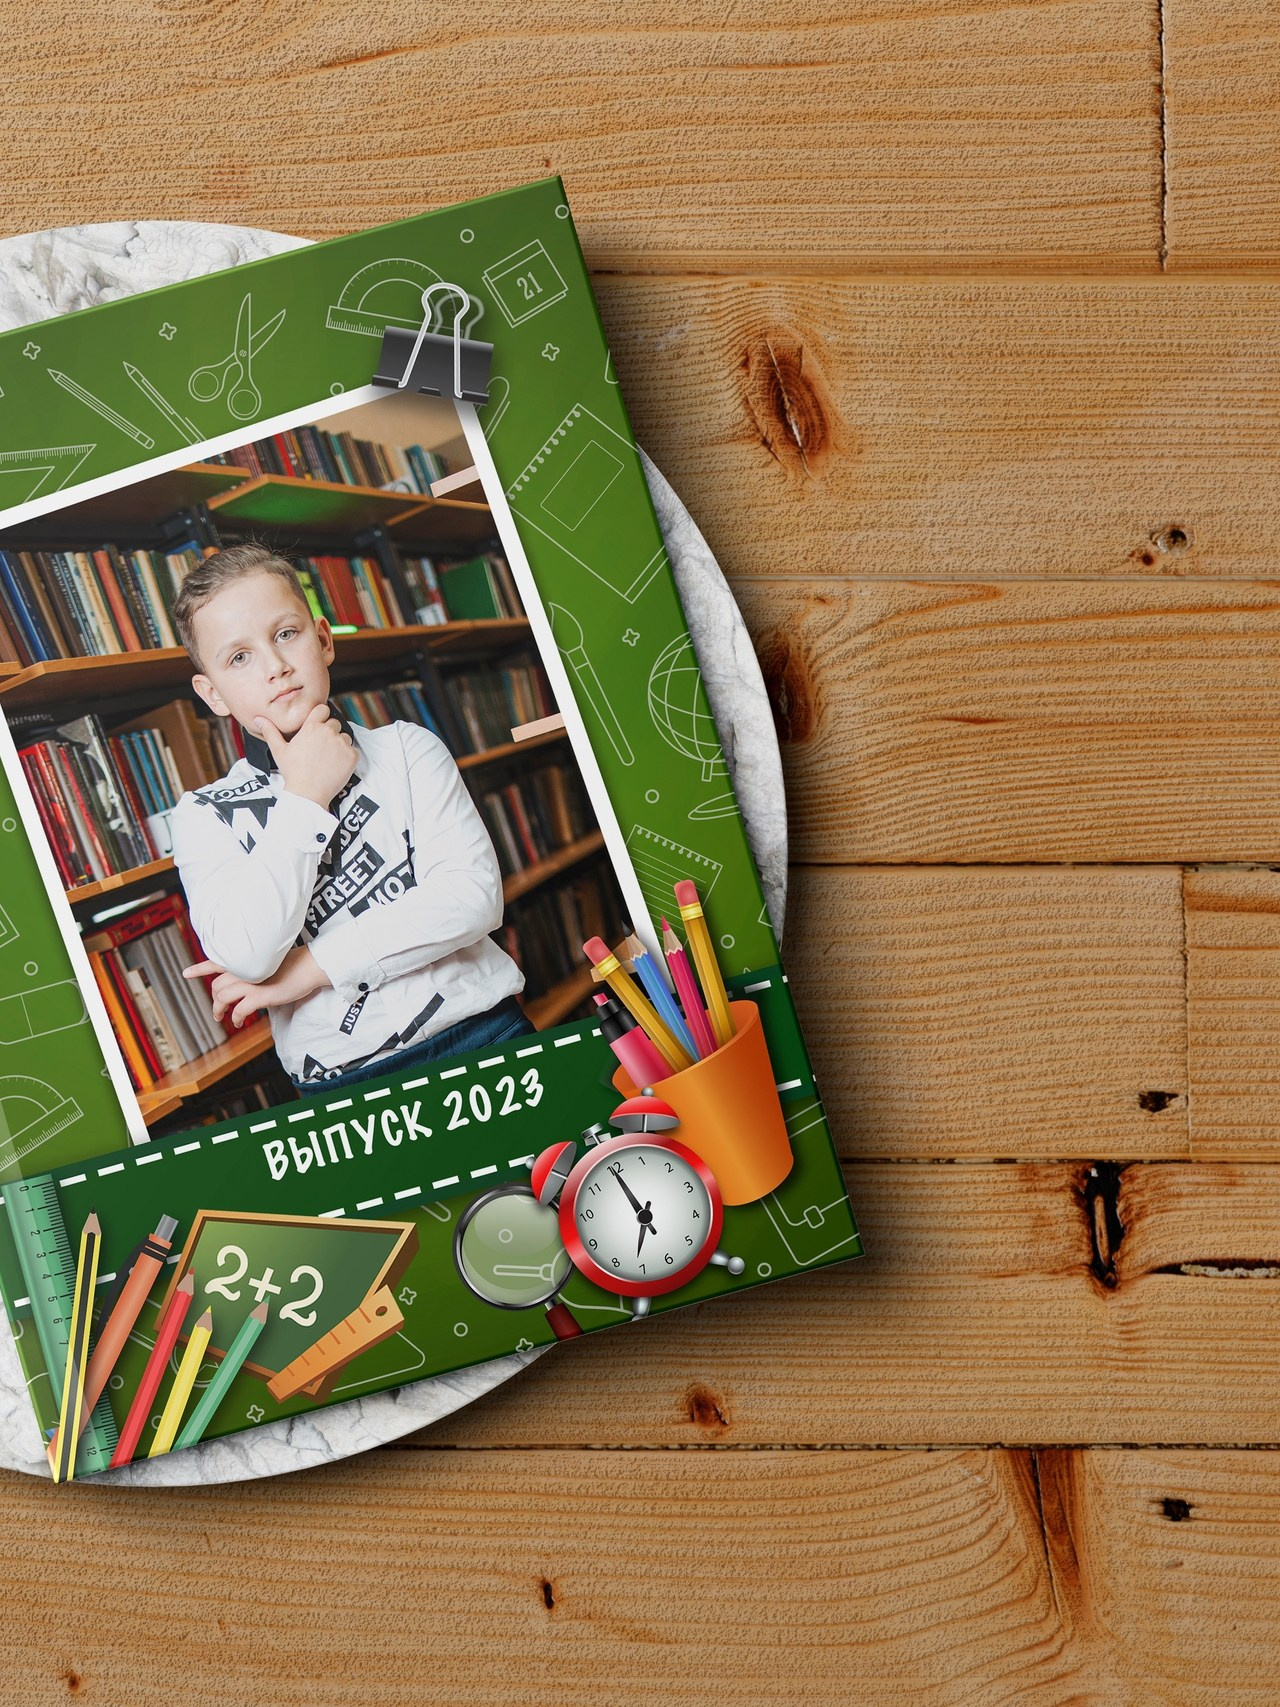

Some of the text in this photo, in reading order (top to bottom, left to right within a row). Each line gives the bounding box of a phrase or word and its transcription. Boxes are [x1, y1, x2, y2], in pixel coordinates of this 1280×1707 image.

[516, 271, 543, 300] 21
[202, 780, 263, 800] YOUR
[339, 804, 370, 850] DGE
[306, 849, 378, 928] STREET
[343, 1002, 363, 1031] JUST
[262, 1068, 544, 1181] ВЫПУСК 2023
[664, 1162, 674, 1173] 2
[588, 1183, 602, 1195] 11
[683, 1181, 694, 1193] 3
[579, 1209, 595, 1222] 10
[692, 1210, 700, 1220] 4
[588, 1239, 598, 1251] 9
[685, 1235, 693, 1246] 5
[612, 1258, 621, 1268] 8
[664, 1253, 674, 1265] 6
[639, 1264, 647, 1275] 7
[204, 1244, 324, 1327] 2+2
